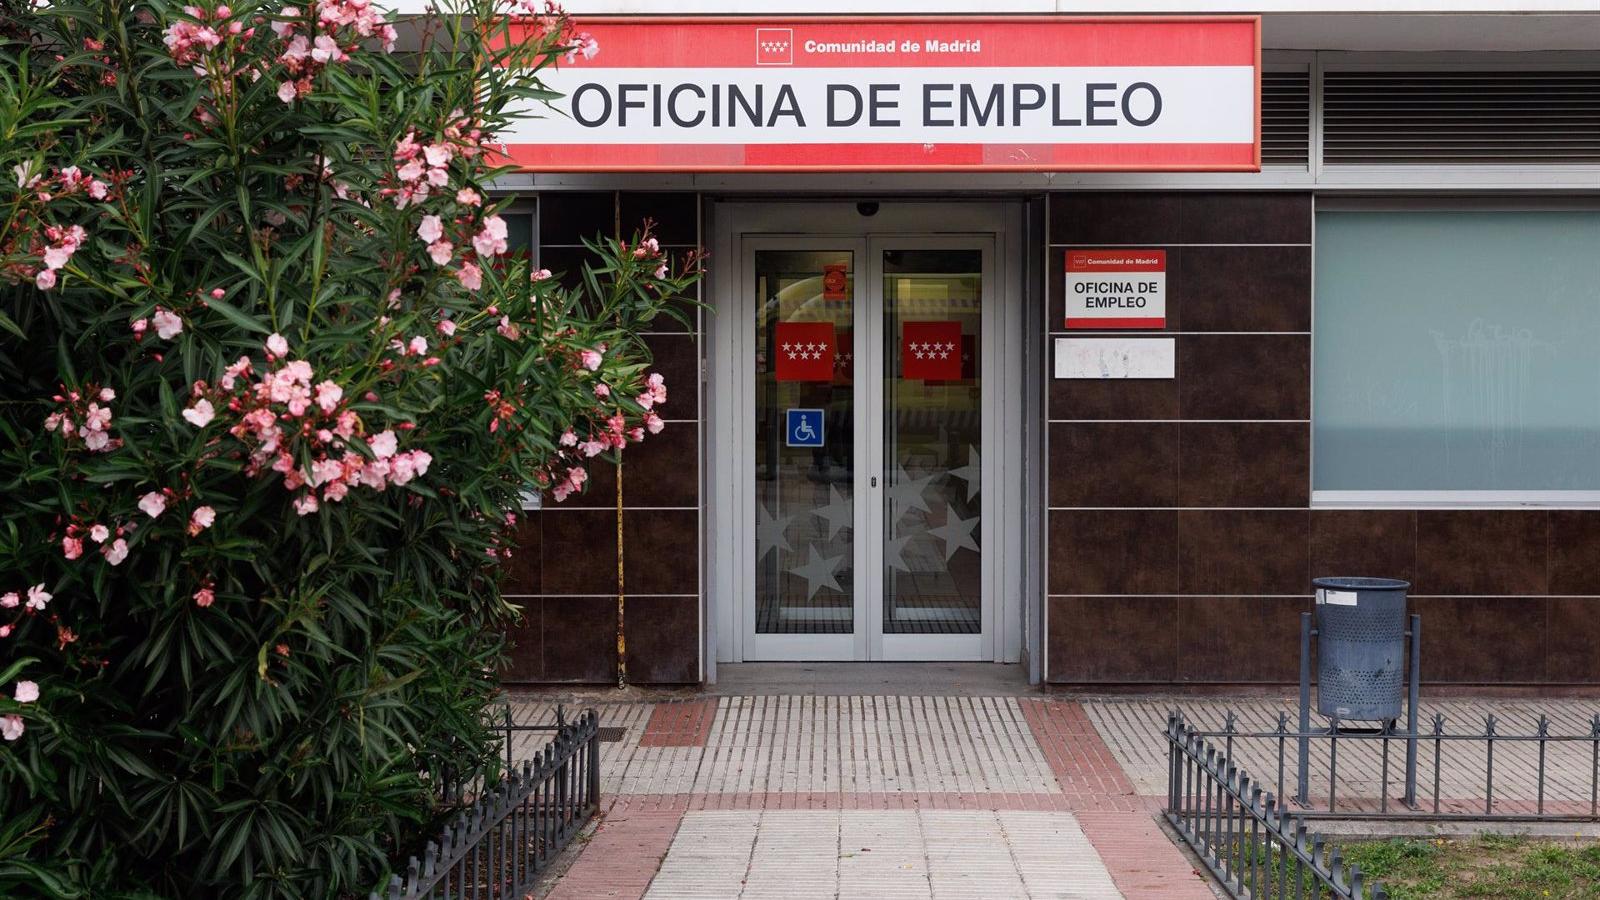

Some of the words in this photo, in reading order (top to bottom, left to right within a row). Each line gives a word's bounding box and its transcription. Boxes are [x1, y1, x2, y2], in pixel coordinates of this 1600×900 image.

[804, 39, 896, 53] Comunidad
[901, 39, 921, 53] de
[925, 39, 981, 53] Madrid
[571, 82, 807, 128] OFICINA
[826, 82, 901, 127] DE
[922, 81, 1163, 128] EMPLEO
[1074, 281, 1134, 294] OFICINA
[1138, 282, 1158, 294] DE
[1085, 296, 1147, 309] EMPLEO
